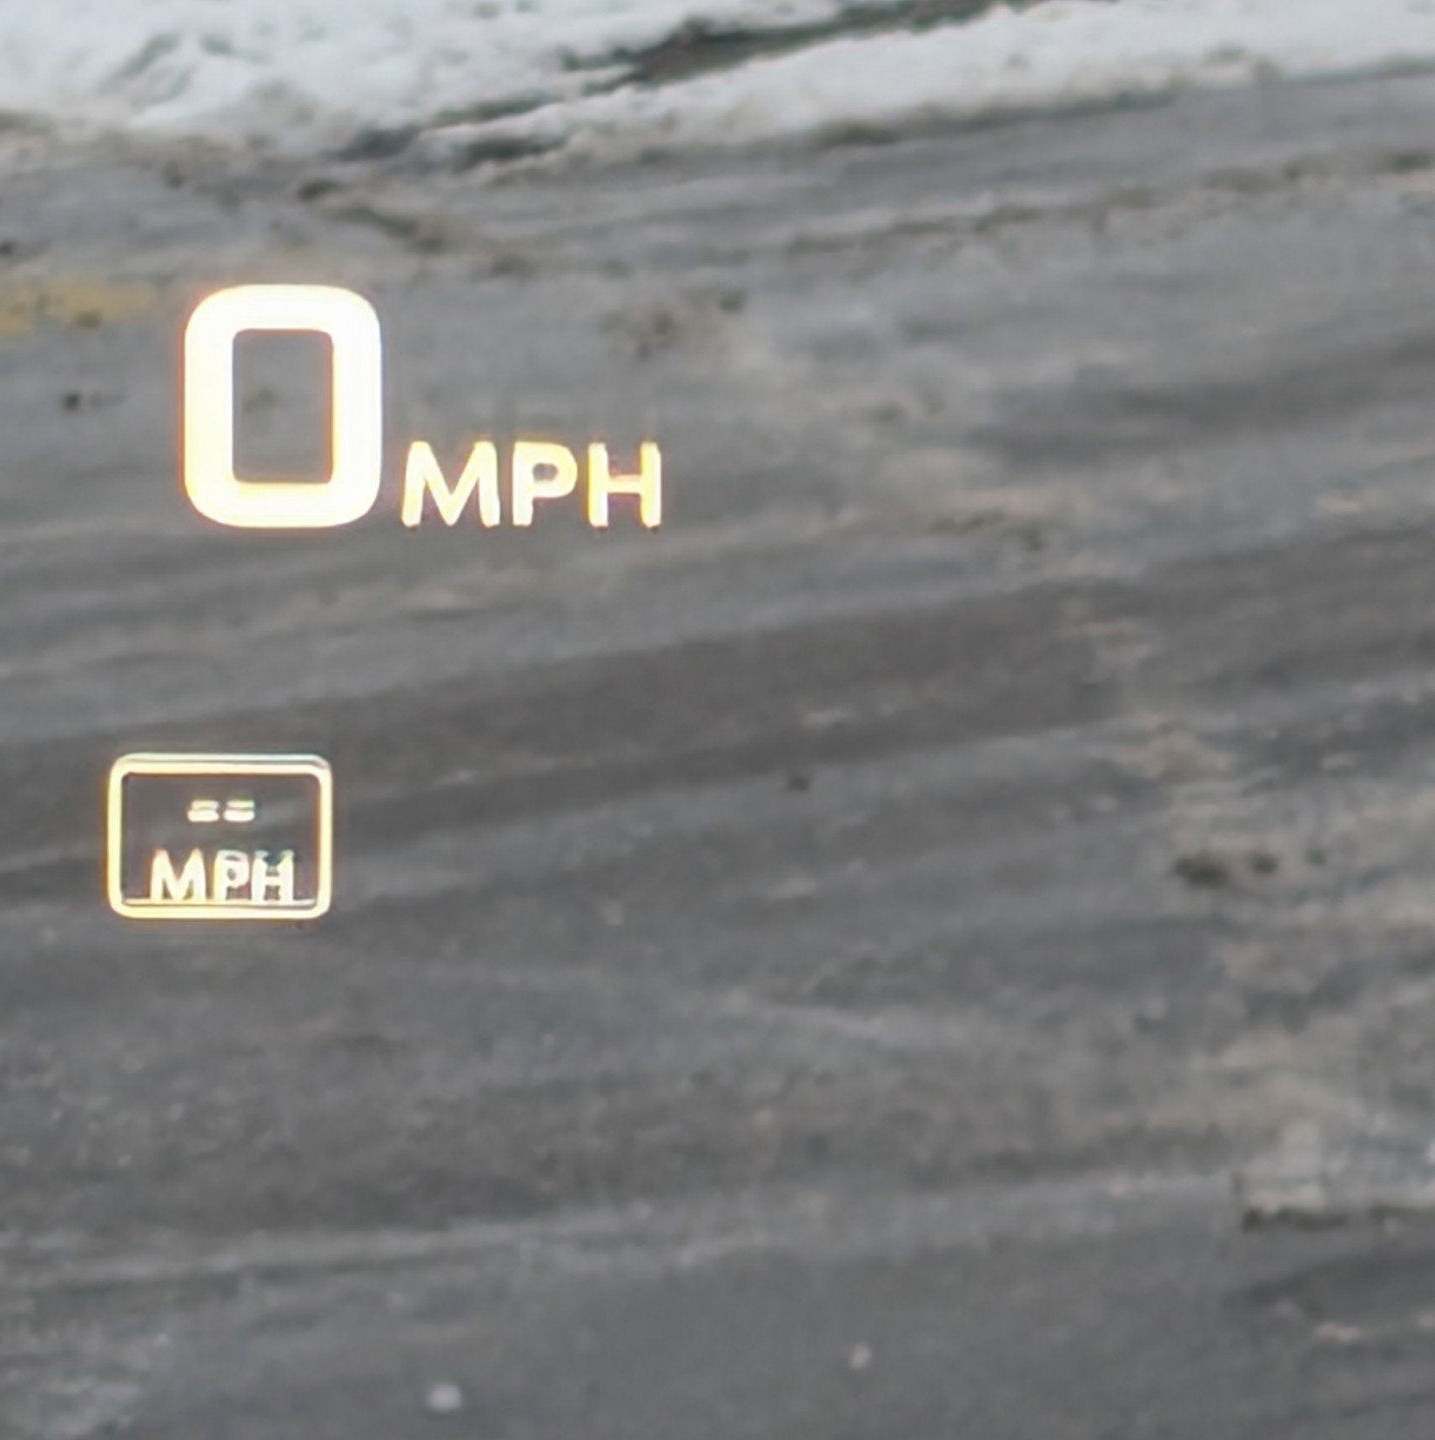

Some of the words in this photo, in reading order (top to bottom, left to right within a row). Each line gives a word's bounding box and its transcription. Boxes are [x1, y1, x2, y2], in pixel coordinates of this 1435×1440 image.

[184, 284, 382, 527] 0
[400, 440, 662, 528] MPH
[149, 848, 295, 902] MPH
